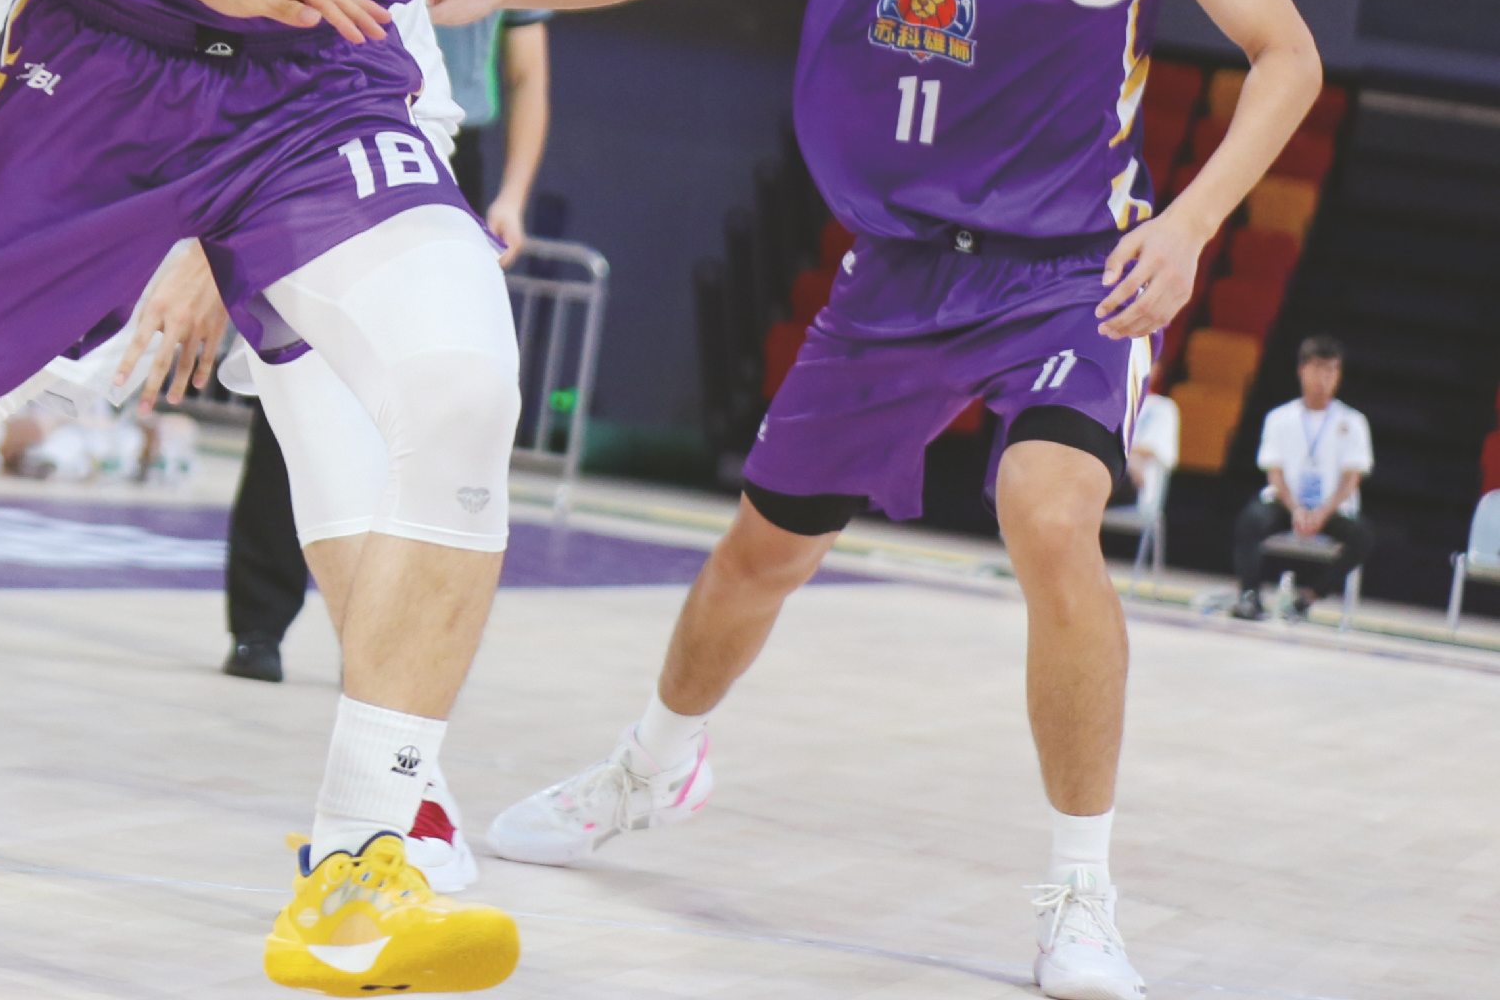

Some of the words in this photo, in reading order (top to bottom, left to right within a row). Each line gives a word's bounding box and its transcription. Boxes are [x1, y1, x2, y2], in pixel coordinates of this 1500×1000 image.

[895, 75, 941, 145] 11
[337, 130, 439, 200] 18
[1030, 348, 1078, 392] 11
